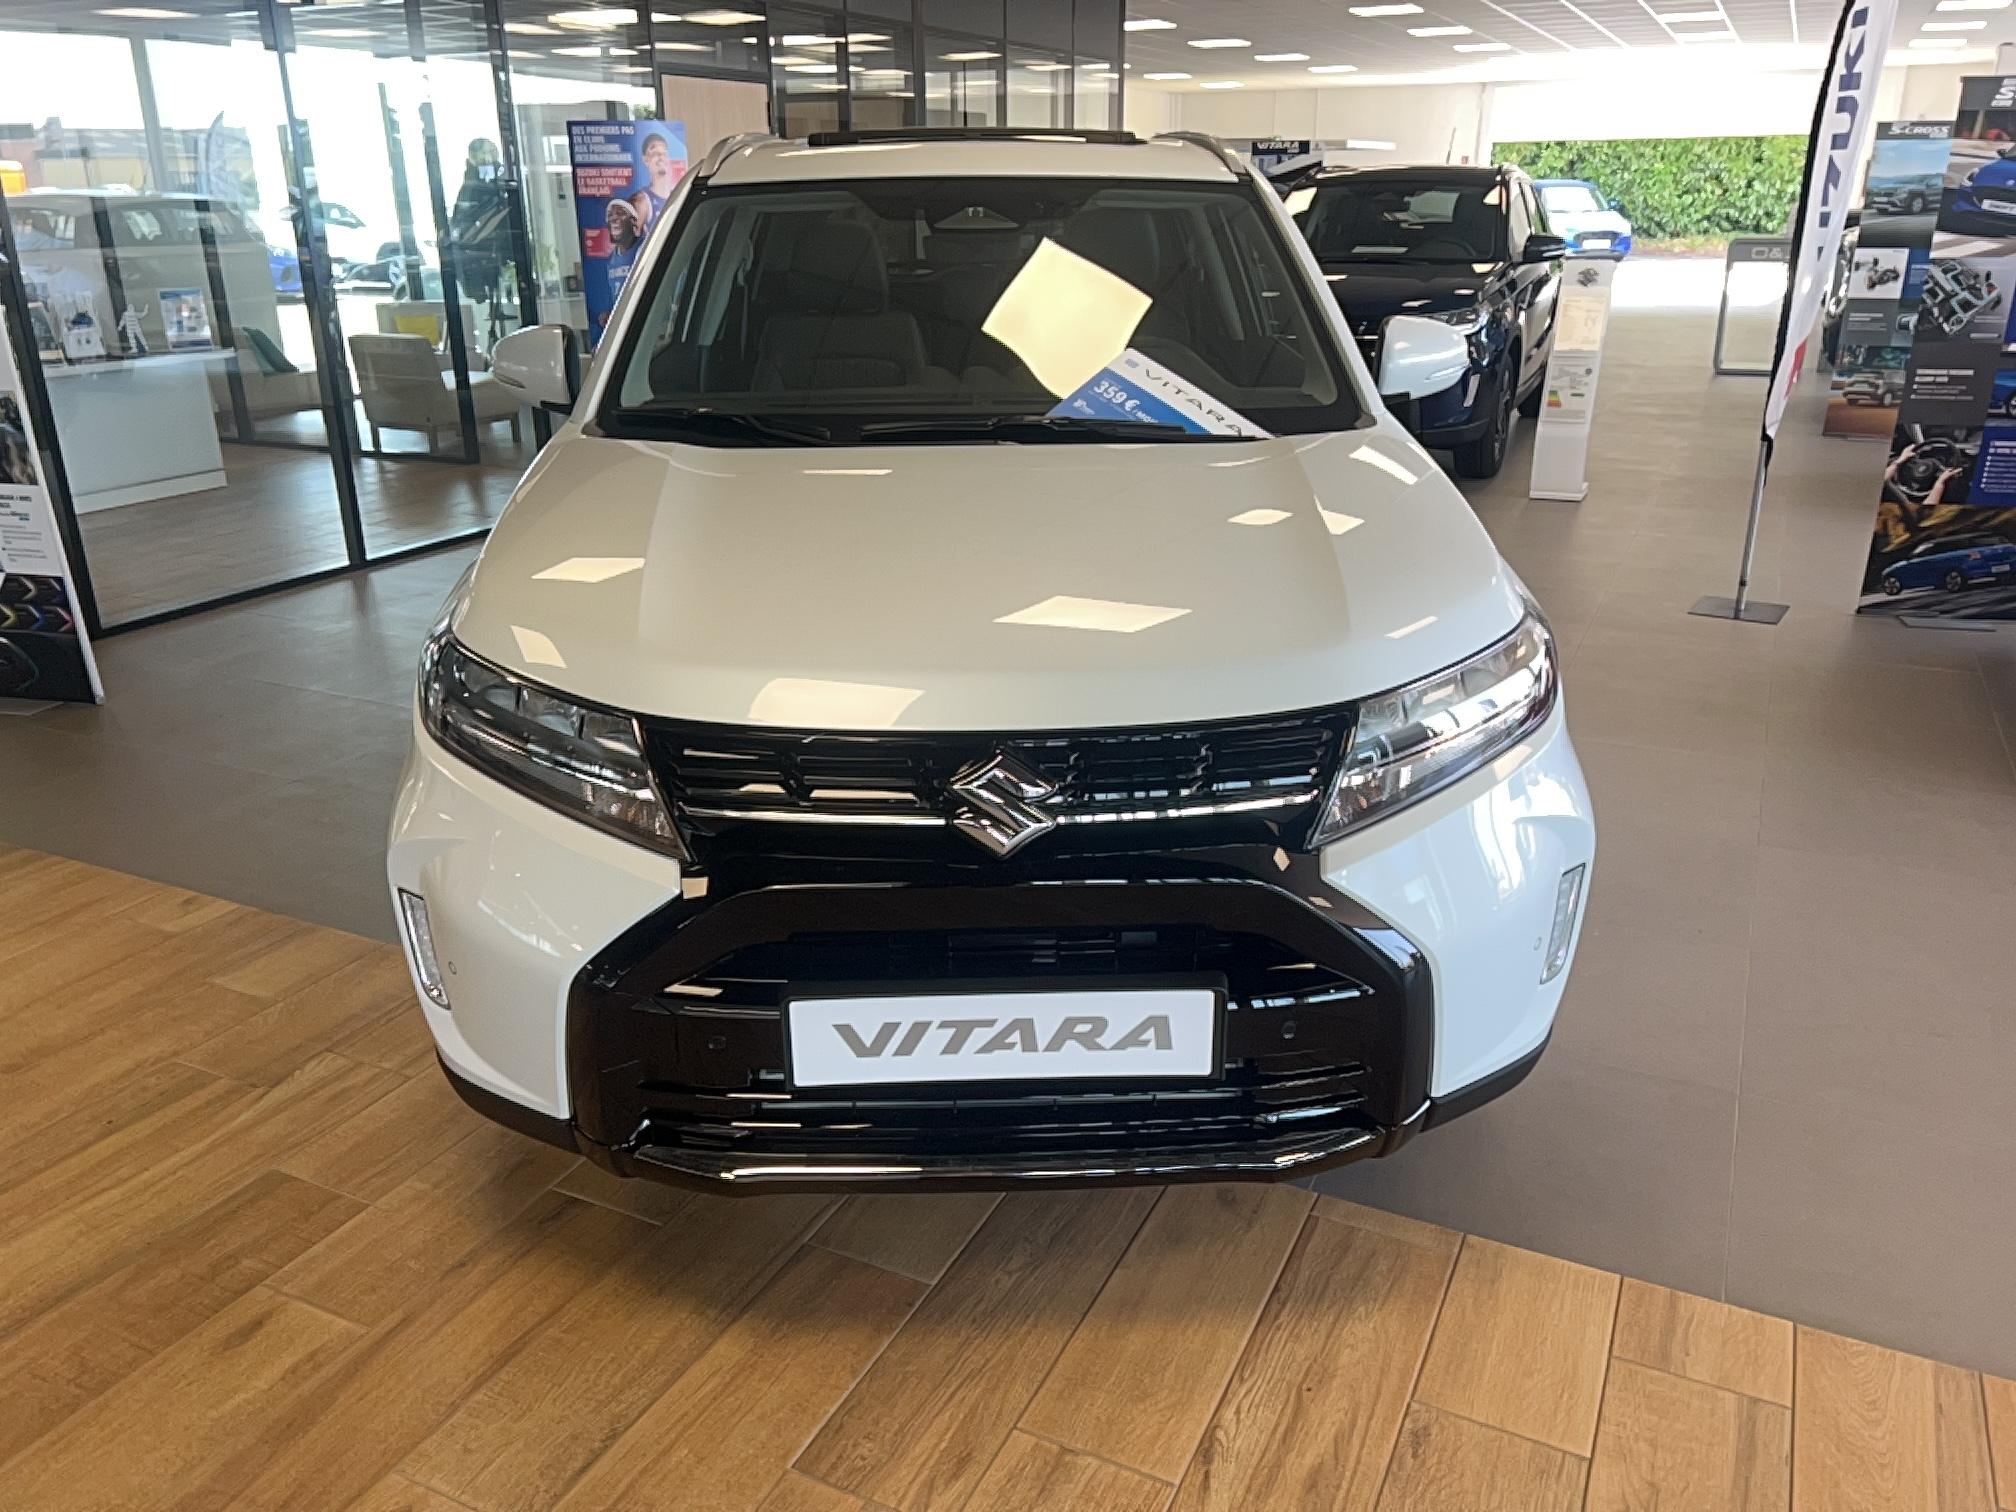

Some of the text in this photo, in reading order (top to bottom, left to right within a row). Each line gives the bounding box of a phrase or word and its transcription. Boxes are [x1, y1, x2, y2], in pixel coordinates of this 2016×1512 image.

[621, 126, 634, 135] PAS
[1146, 369, 1242, 437] VITARA
[832, 1015, 1173, 1058] VITARA
